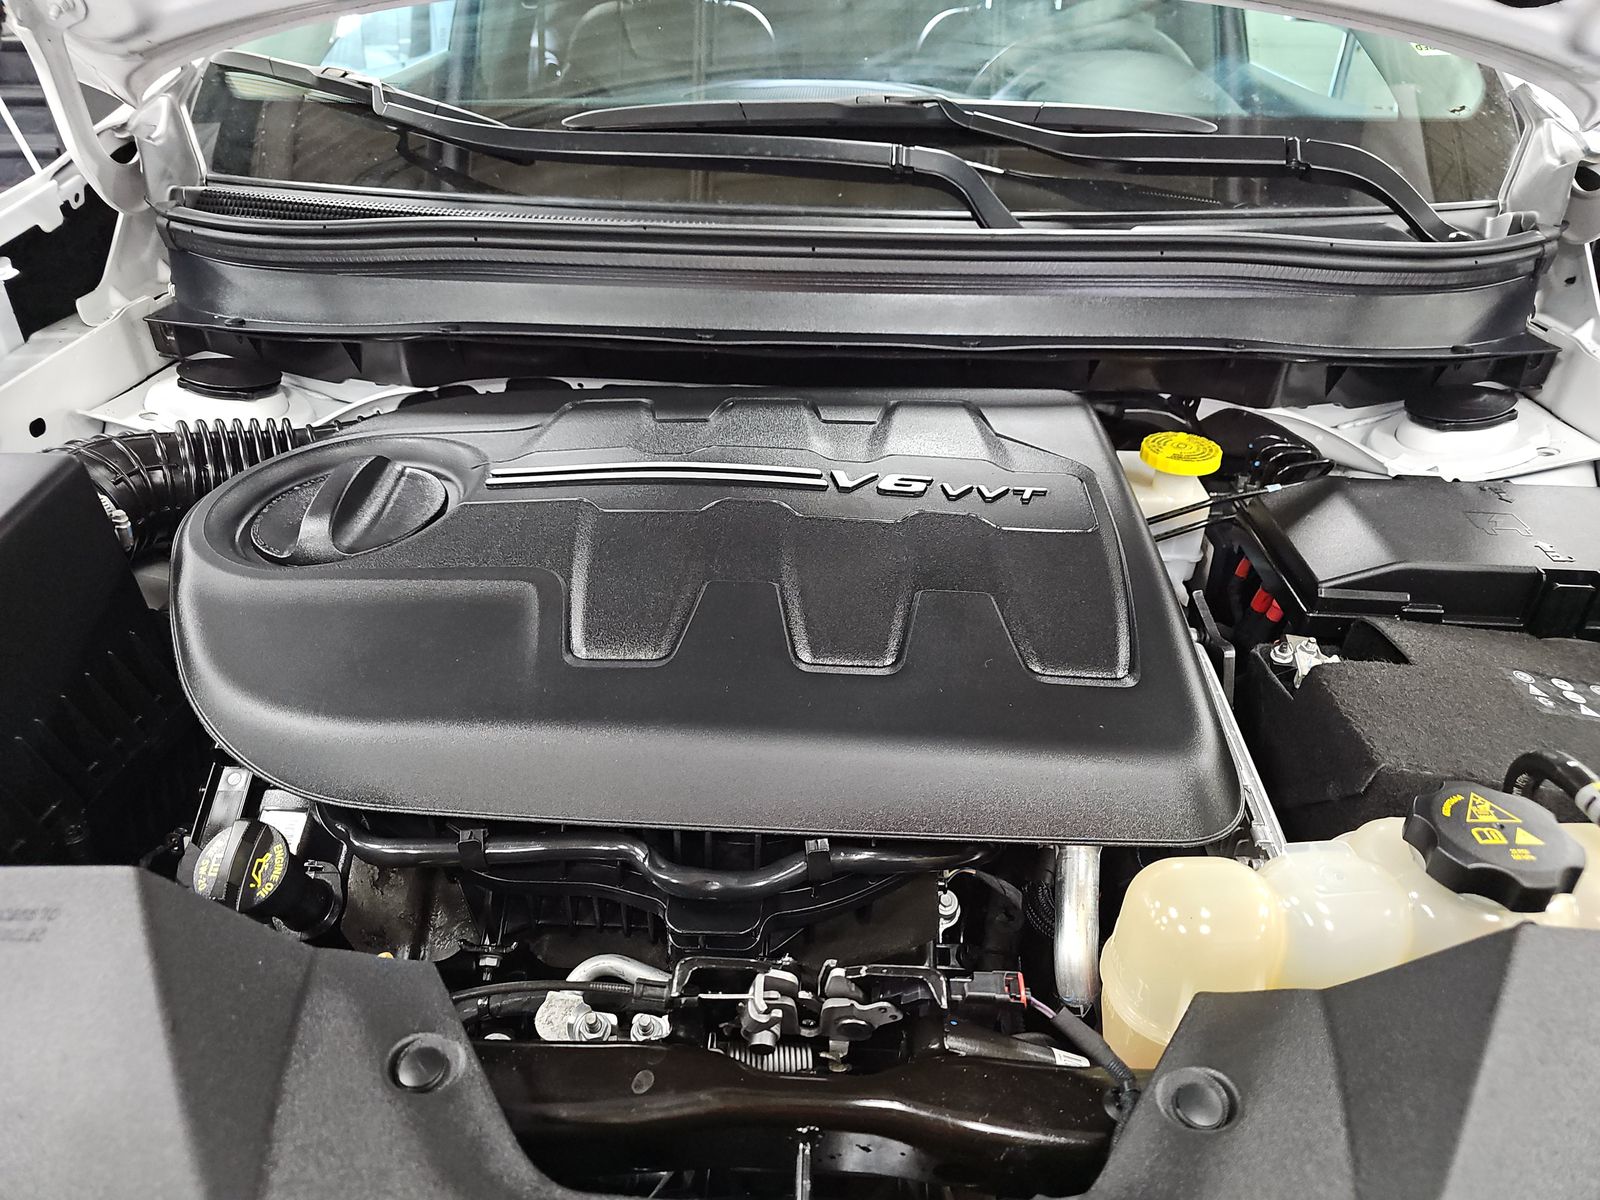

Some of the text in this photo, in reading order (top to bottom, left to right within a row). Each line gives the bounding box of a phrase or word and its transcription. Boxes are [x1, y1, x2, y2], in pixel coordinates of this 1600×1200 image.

[830, 469, 1048, 505] V6 VVT
[256, 843, 284, 898] ENGINE OIL
